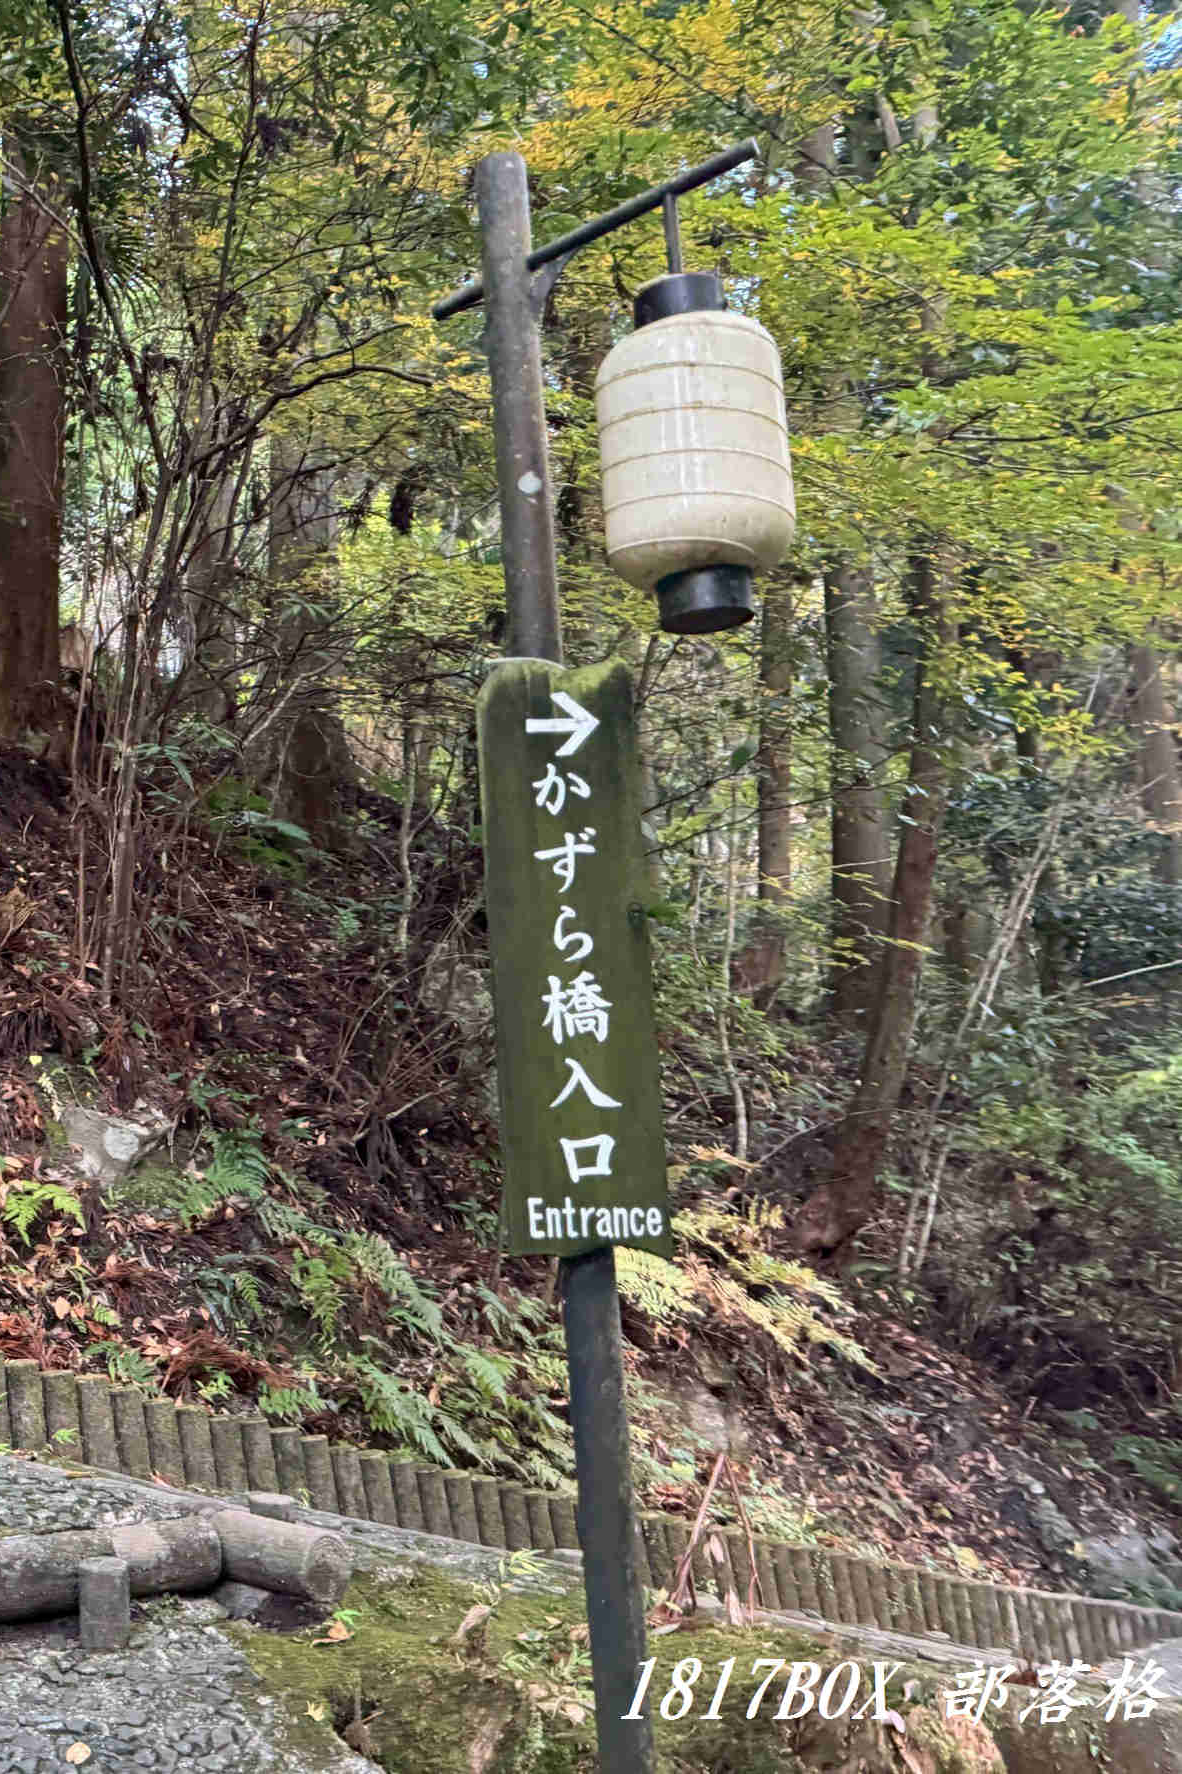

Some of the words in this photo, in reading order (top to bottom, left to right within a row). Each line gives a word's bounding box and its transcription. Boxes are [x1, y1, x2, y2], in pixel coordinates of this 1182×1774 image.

[532, 763, 622, 1183] かずら橋入口
[528, 1197, 663, 1239] Entrance
